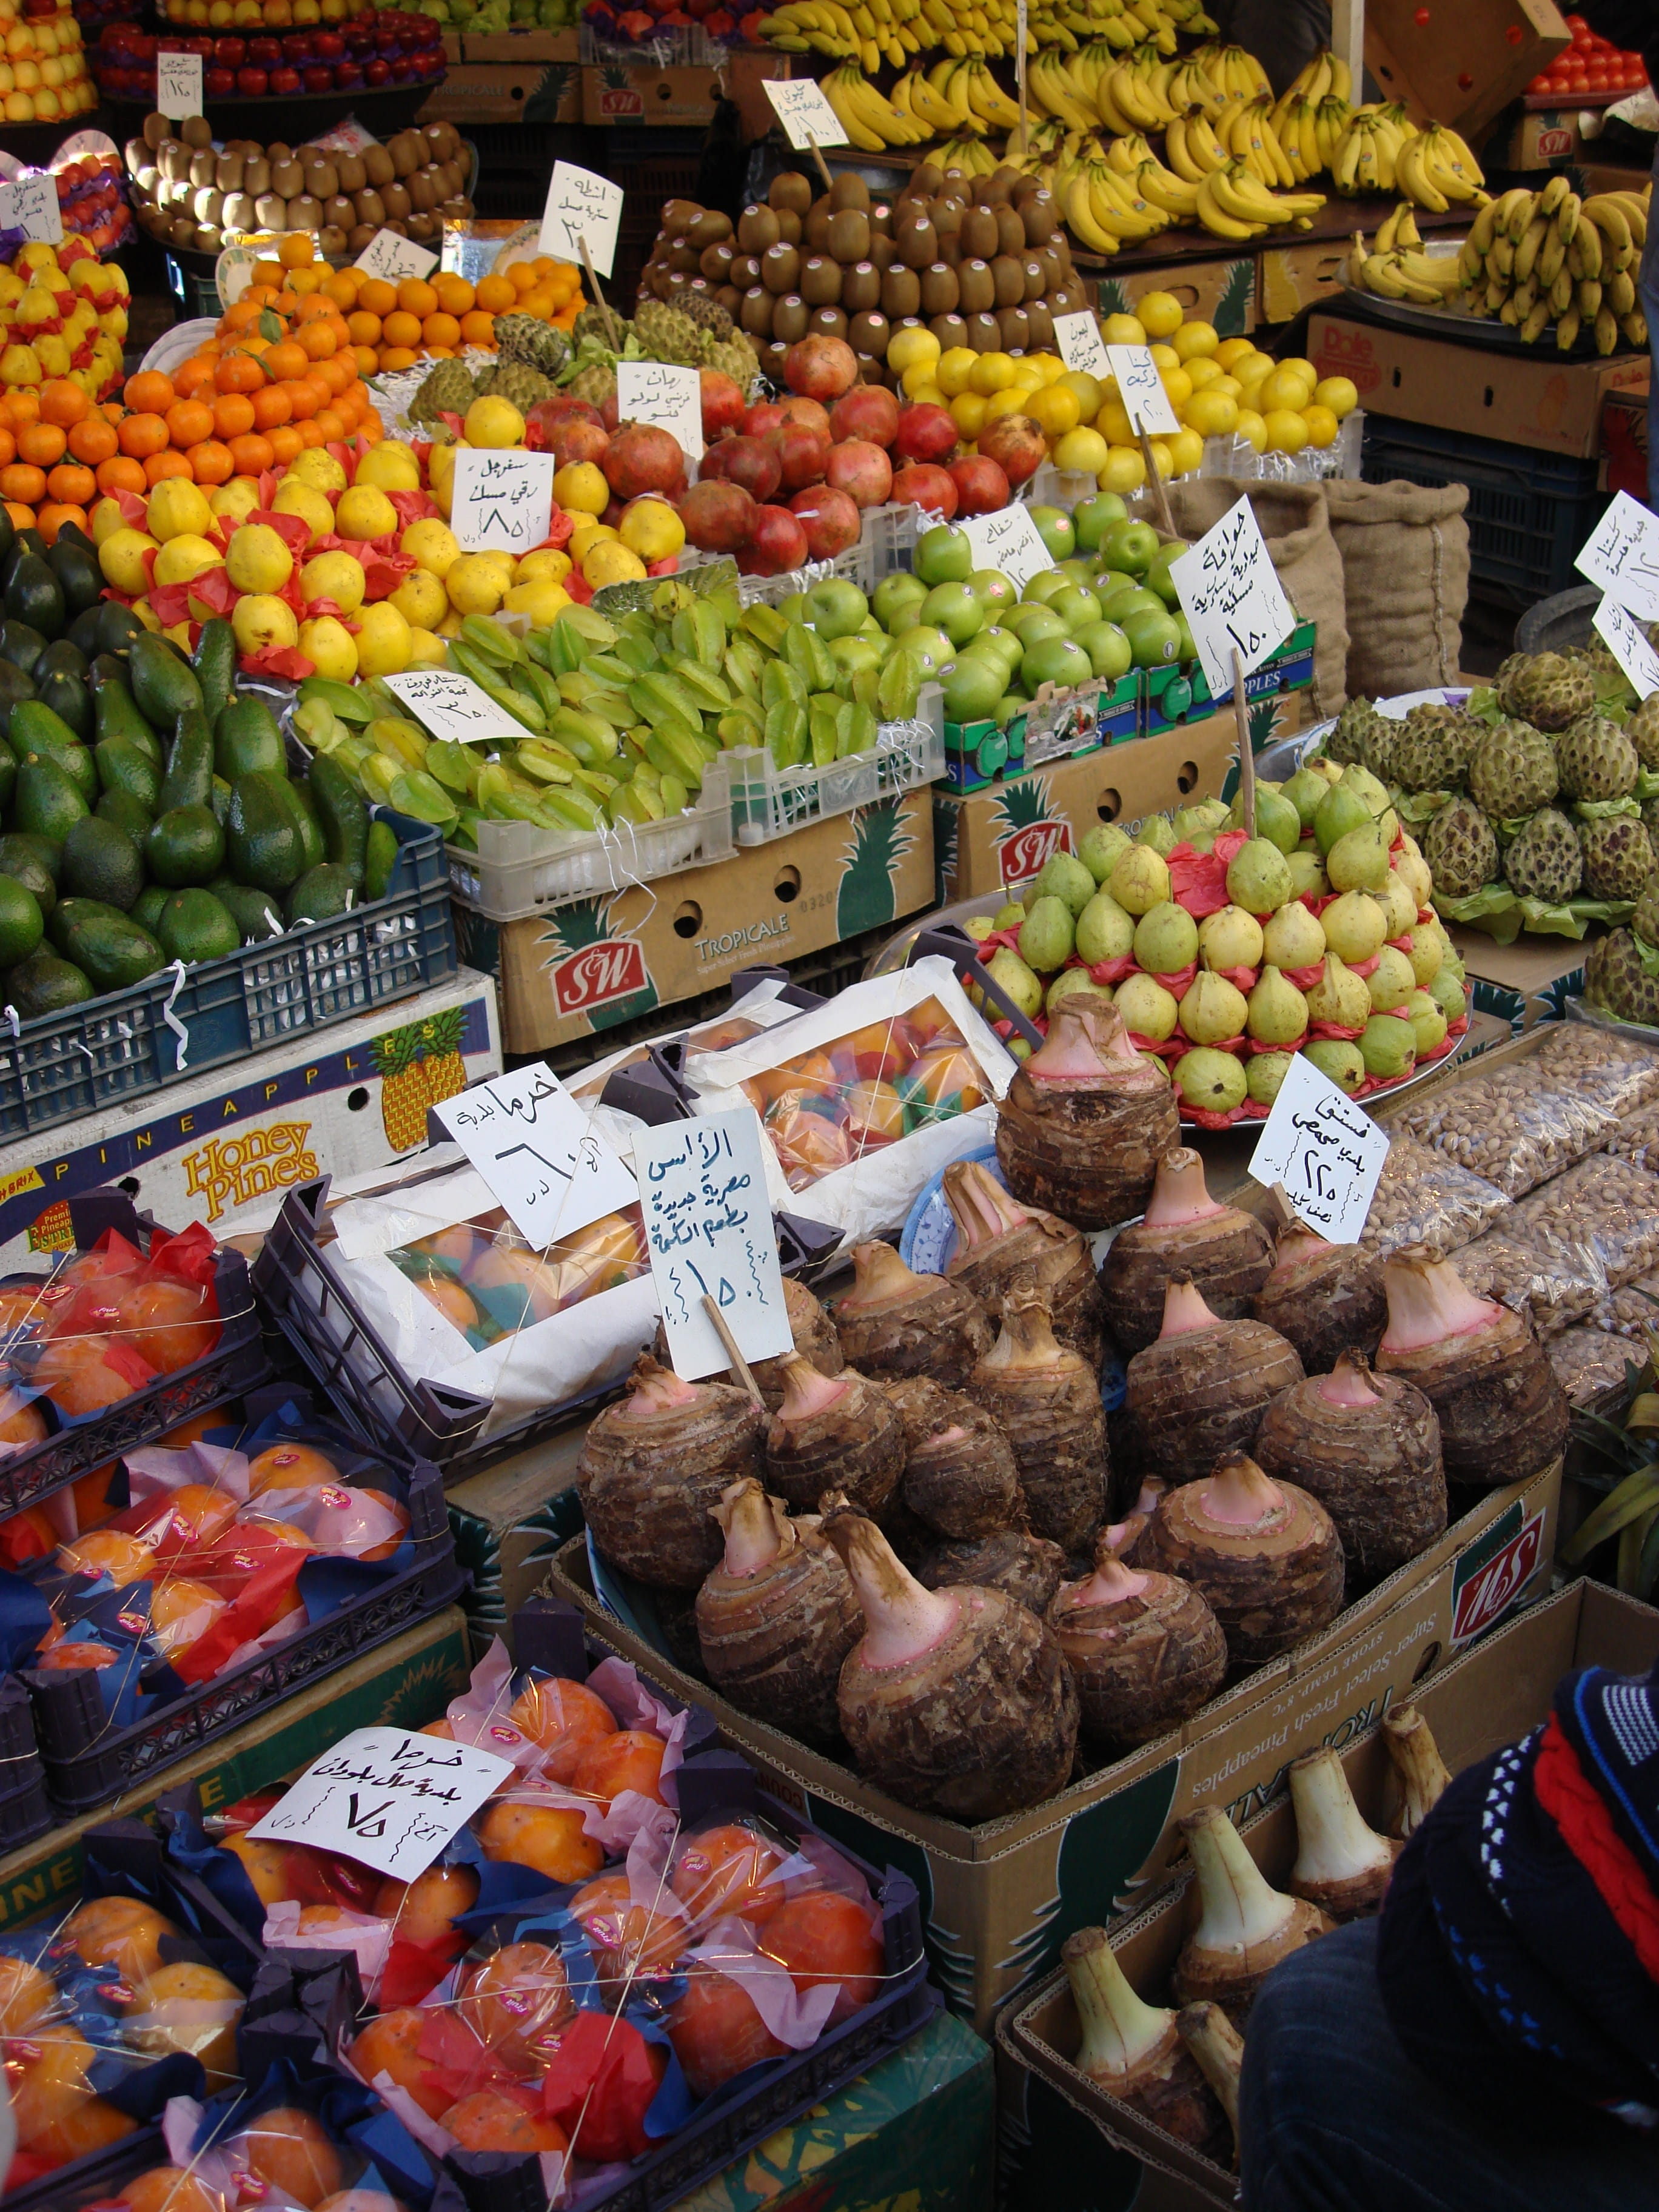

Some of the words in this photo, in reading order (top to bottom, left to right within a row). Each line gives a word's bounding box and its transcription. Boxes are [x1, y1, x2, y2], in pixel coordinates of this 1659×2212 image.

[800, 116, 830, 136] ١٠٠
[1324, 325, 1374, 357] Dole
[646, 369, 682, 390] رمان
[481, 458, 529, 478] سفرجل
[510, 480, 538, 504] رقي
[483, 508, 524, 538] ٨٥
[987, 518, 1013, 545] تفاح
[1226, 623, 1267, 659] ١٥٠
[436, 701, 487, 720] ٣٥٠
[694, 913, 790, 961] TROPICALE
[563, 943, 633, 1005] S&W
[484, 1072, 558, 1124] خرما
[457, 1103, 495, 1131] بلدية
[1315, 1093, 1371, 1139] فستق
[181, 1121, 312, 1197] Honey
[1304, 1150, 1336, 1201] ٢٢٥
[1336, 1147, 1365, 1176] بلدي
[8, 1170, 34, 1195] BRIX
[201, 1150, 320, 1224] Pines
[701, 1173, 751, 1206] مصرية
[44, 1208, 70, 1224] Premi
[651, 1190, 697, 1221] جديدة
[703, 1204, 749, 1248] بطعم
[686, 1259, 752, 1307] ١٥٠
[173, 1523, 187, 1537] Fruit
[1342, 1631, 1385, 1669] STORE
[1396, 1612, 1437, 1658] Super
[1298, 1666, 1339, 1699] TEMP.
[1343, 1649, 1393, 1696] Select
[1293, 1689, 1341, 1732] Fresh
[390, 1738, 464, 1771] خرما
[1192, 1724, 1291, 1799] Pineapples
[346, 1791, 397, 1838] ٧٥
[686, 1862, 705, 1872] Fruit
[592, 1927, 612, 1943] Fruit
[506, 1999, 528, 2013] Fruit
